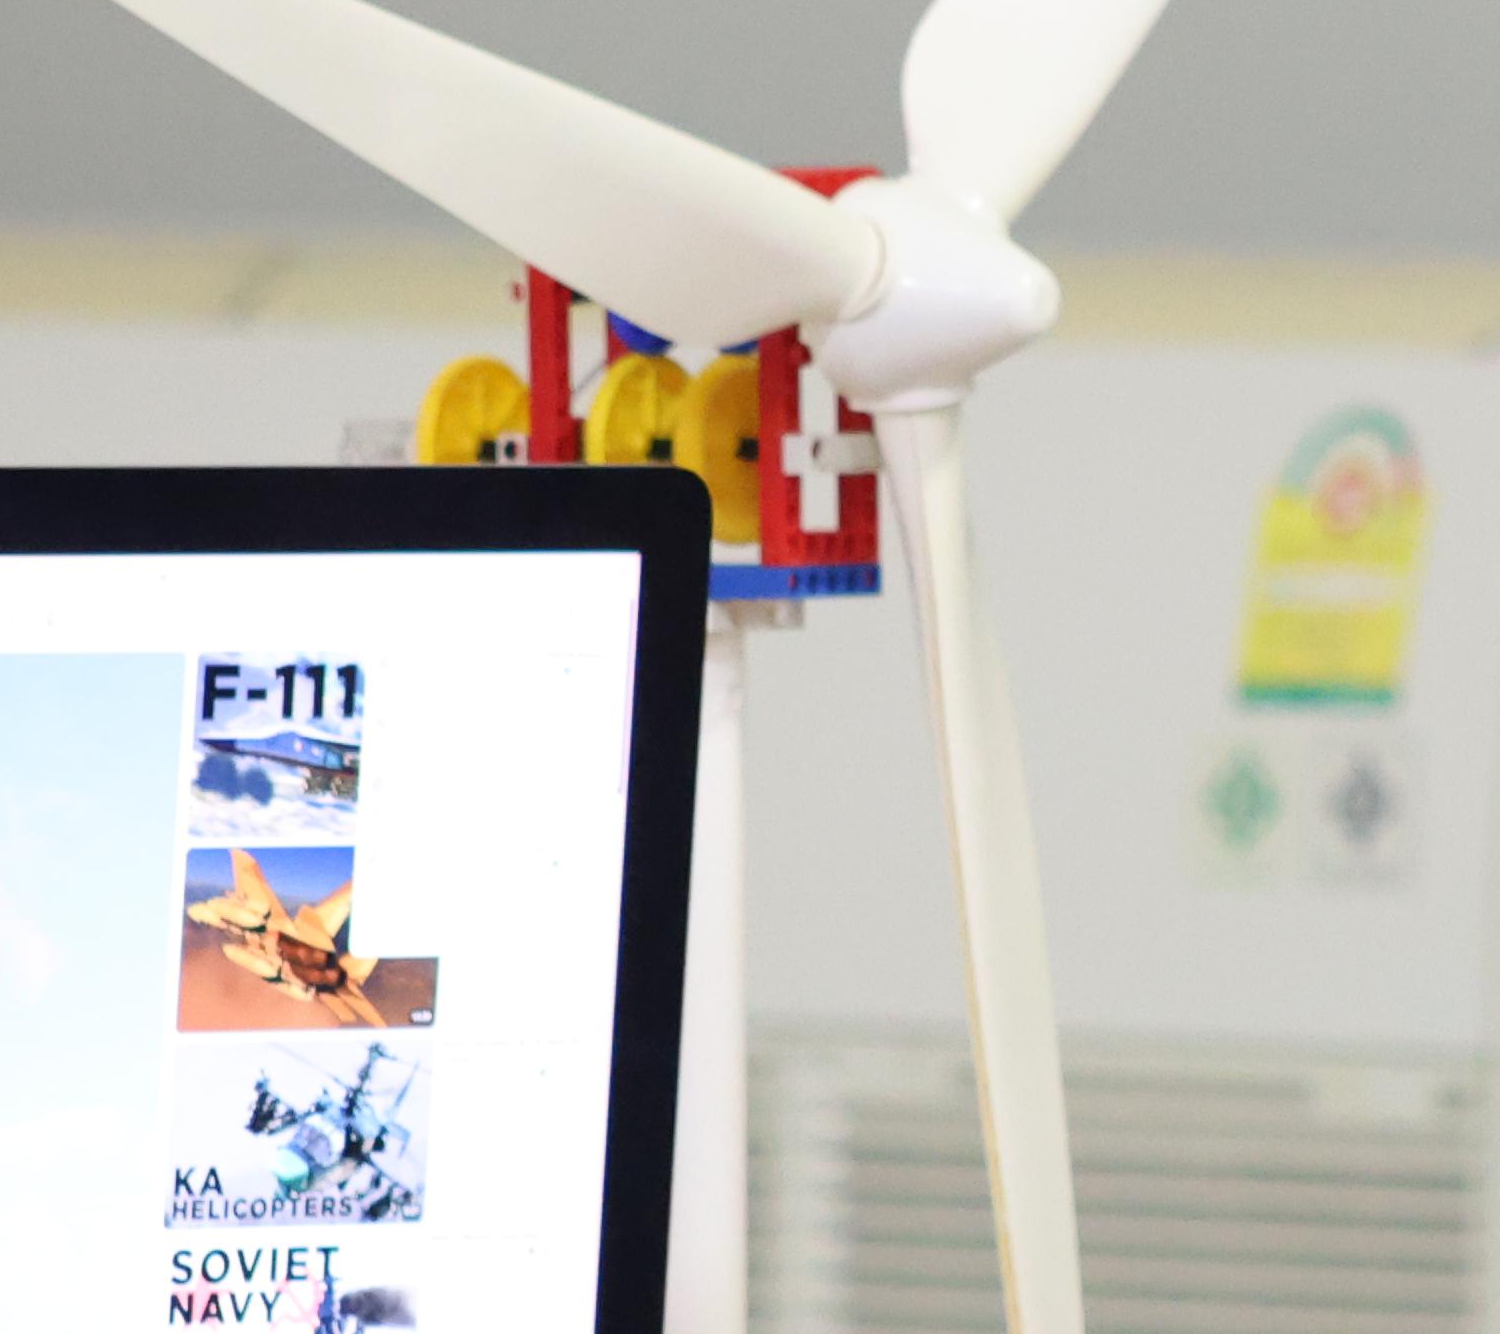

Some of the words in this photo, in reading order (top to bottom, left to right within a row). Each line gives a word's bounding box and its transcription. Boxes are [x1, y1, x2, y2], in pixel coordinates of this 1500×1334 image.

[202, 664, 358, 721] F-111
[175, 1167, 224, 1197] KA
[171, 1196, 353, 1221] HELICOPTERS
[171, 1247, 340, 1285] SOVIET
[169, 1291, 282, 1325] NAVY
